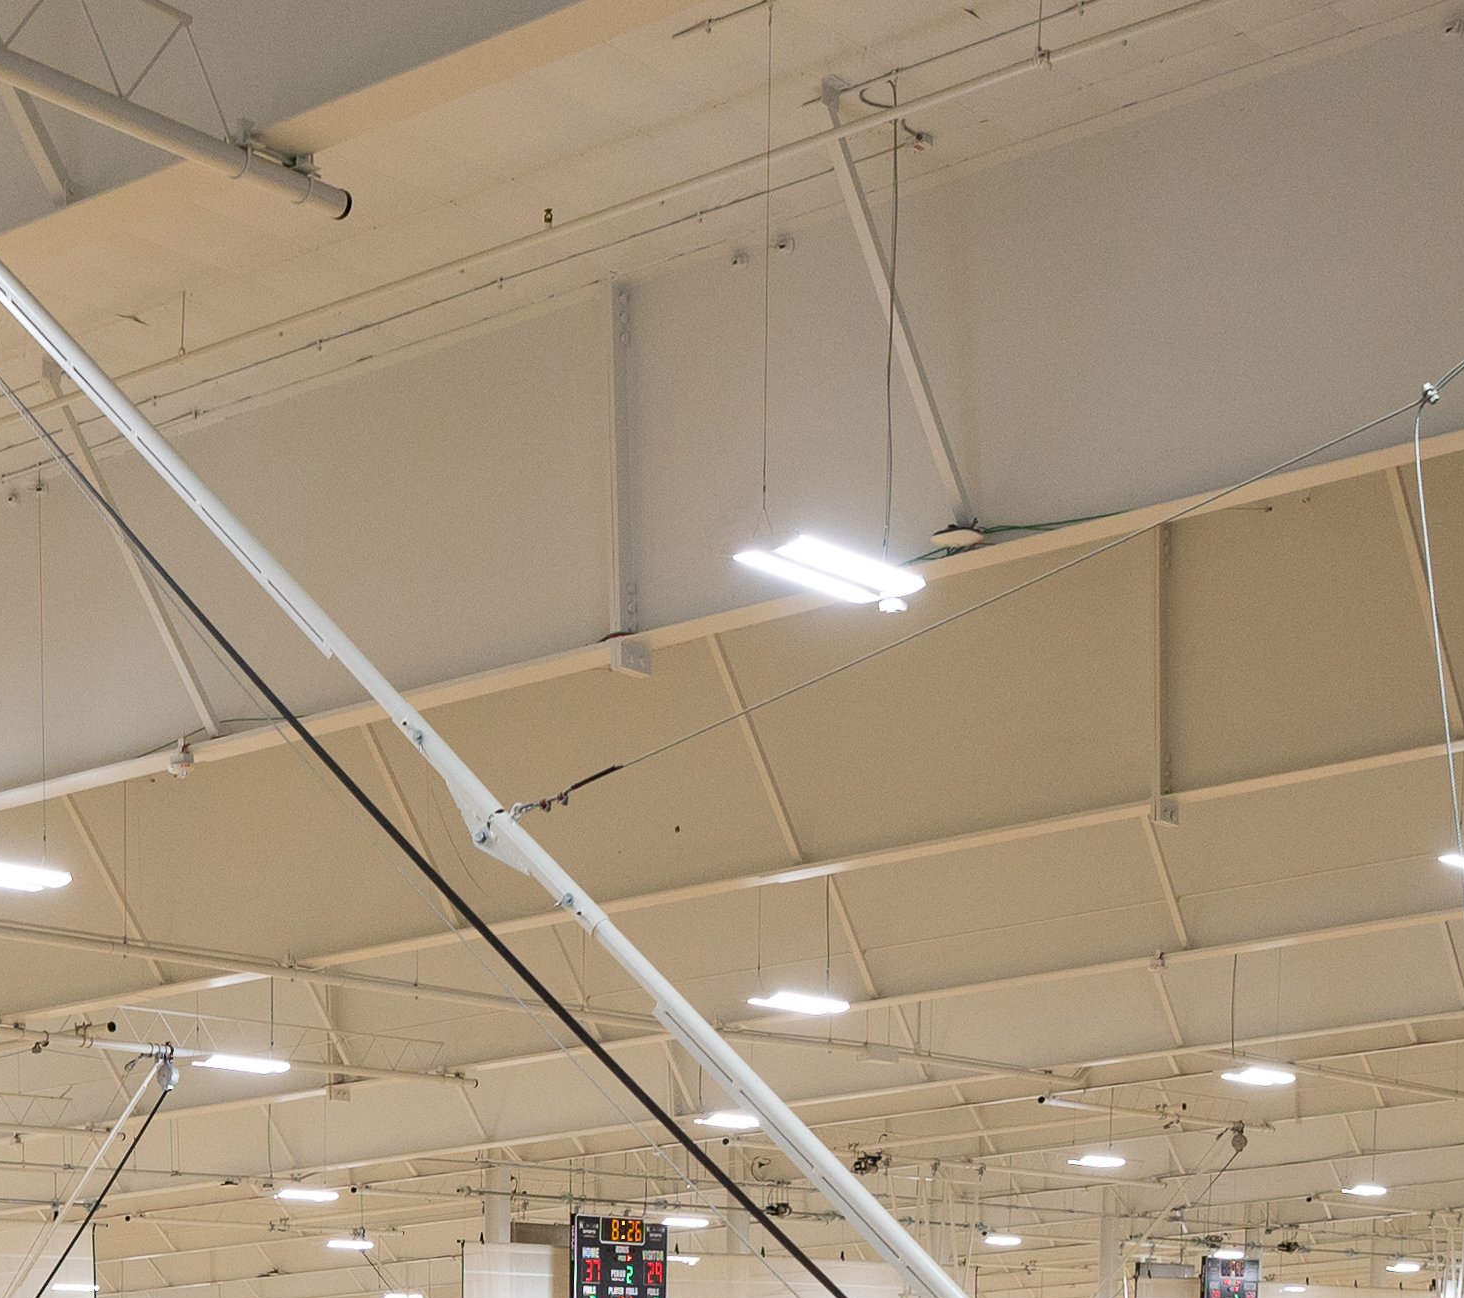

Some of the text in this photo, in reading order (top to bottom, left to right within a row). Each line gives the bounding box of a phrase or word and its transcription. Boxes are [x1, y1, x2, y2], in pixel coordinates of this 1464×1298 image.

[611, 1219, 642, 1242] 8:26
[585, 1260, 601, 1282] 37
[626, 1265, 633, 1284] 2
[647, 1261, 663, 1284] 29
